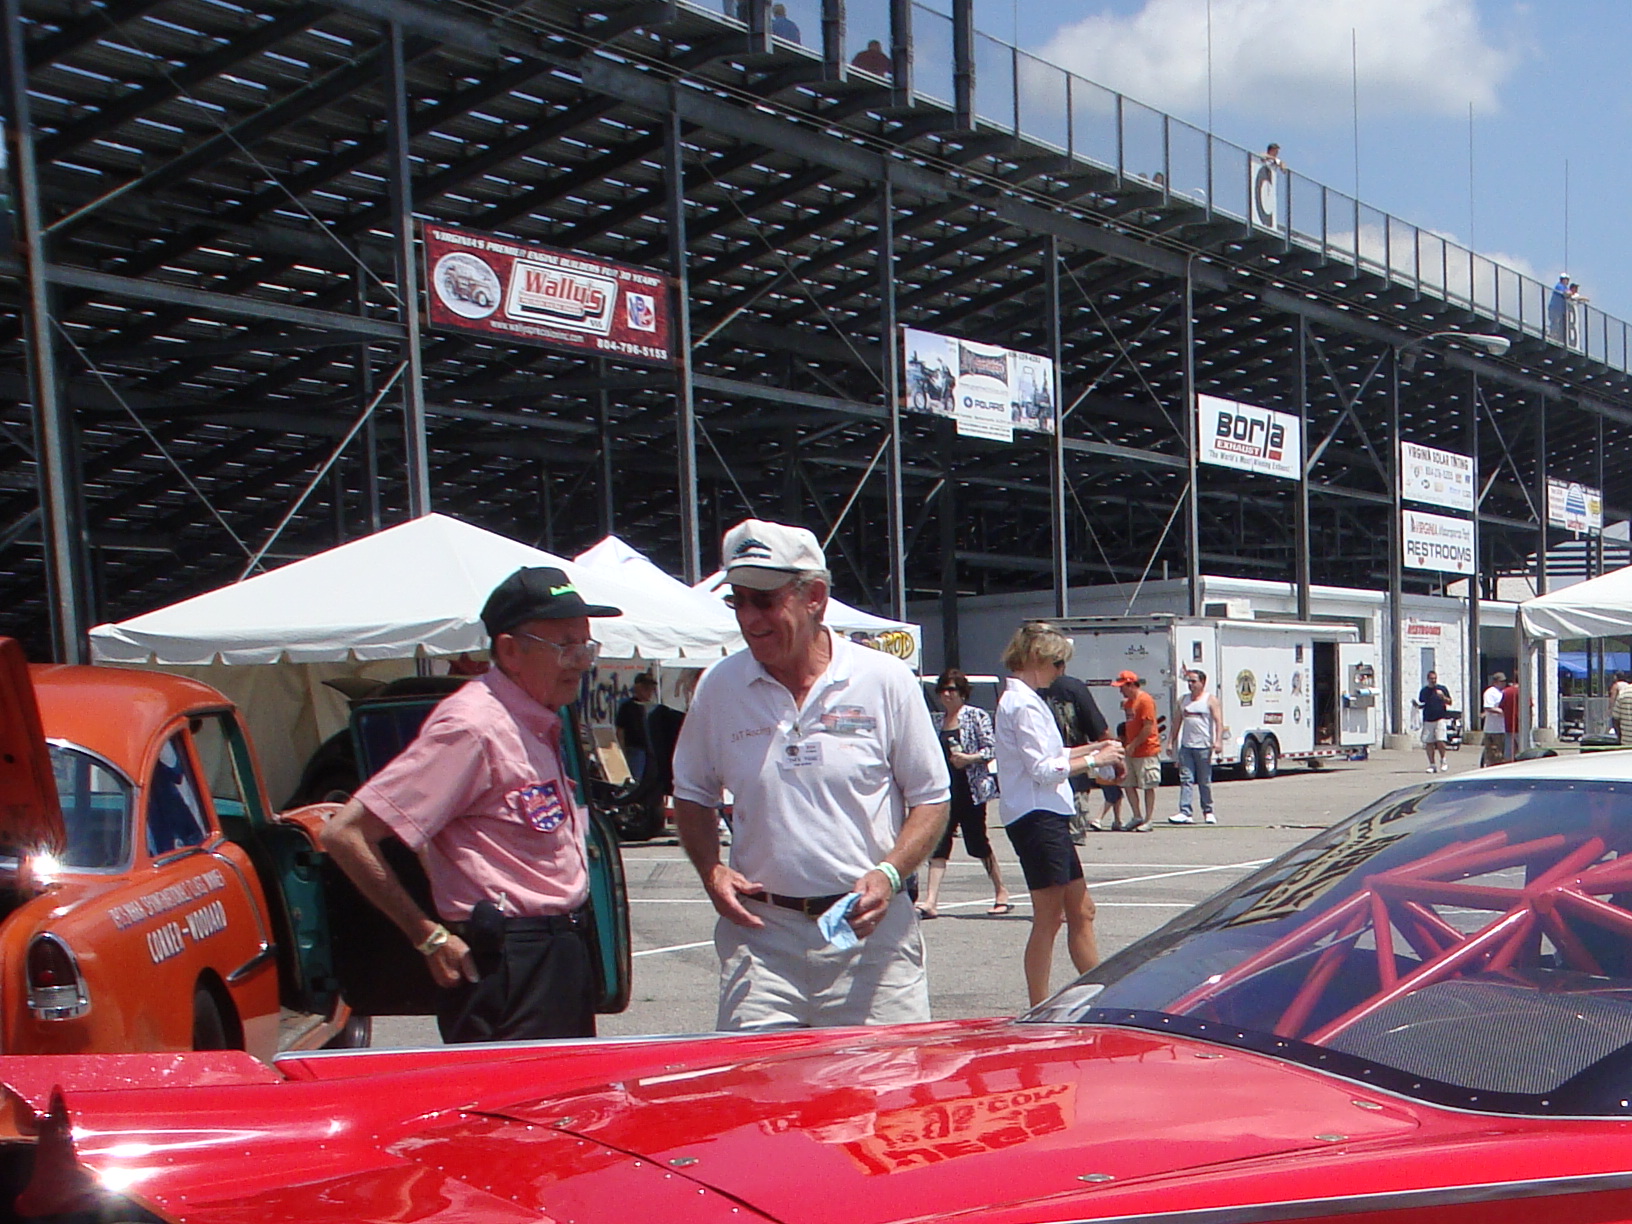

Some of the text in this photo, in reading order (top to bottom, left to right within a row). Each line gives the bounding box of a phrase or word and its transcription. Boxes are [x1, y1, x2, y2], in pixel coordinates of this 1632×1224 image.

[525, 269, 604, 309] Wally's
[974, 399, 1005, 413] POLARIS
[1216, 440, 1260, 456] EXHAUST
[1407, 540, 1472, 563] RESTROOMS
